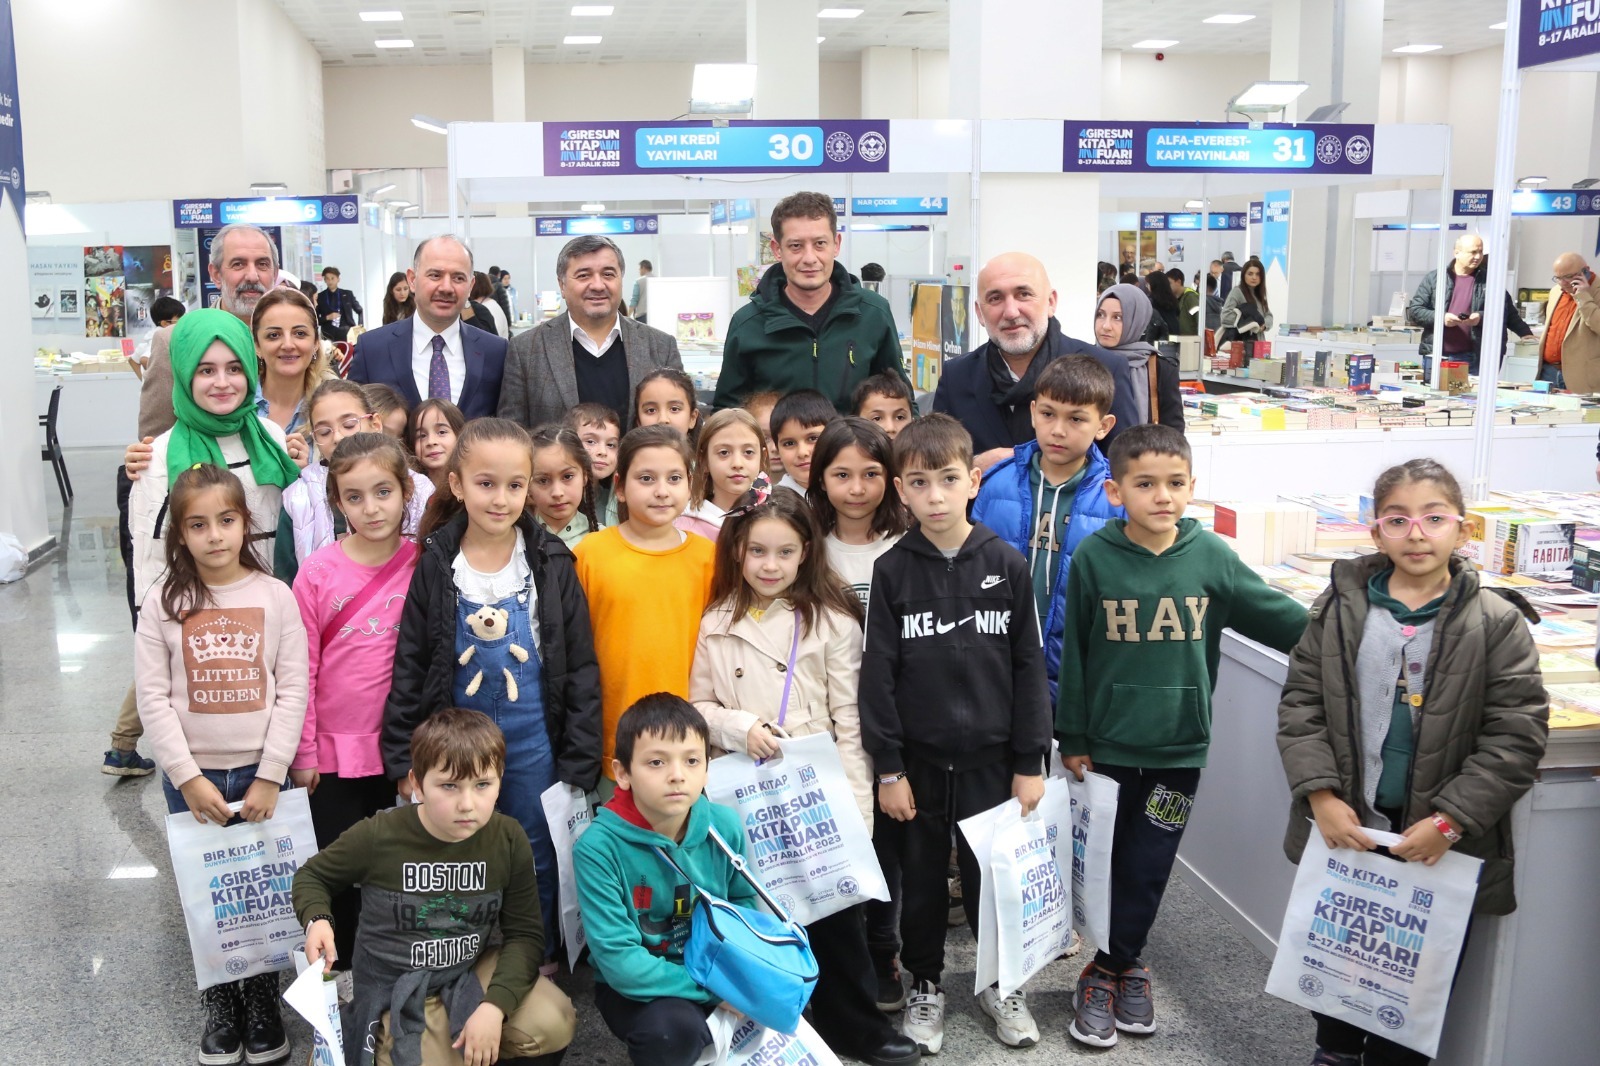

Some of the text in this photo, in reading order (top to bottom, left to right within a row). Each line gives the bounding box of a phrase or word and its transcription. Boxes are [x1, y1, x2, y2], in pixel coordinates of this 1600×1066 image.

[1562, 20, 1600, 41] ARALI
[646, 132, 720, 145] YAPI KREDİ
[768, 134, 814, 160] 30
[580, 150, 620, 160] FUARI
[646, 149, 717, 160] YAYINLARI
[1096, 149, 1132, 159] FUARI
[1156, 150, 1250, 161] KAPI YAYINLARI
[1272, 136, 1306, 162] 31
[304, 204, 317, 218] 6
[874, 199, 898, 207] ÇOCUK
[920, 198, 943, 209] 44
[1552, 196, 1572, 210] 43
[623, 220, 631, 230] 5
[1218, 218, 1225, 226] 3
[945, 341, 962, 354] Orhan
[1533, 547, 1569, 563] RABITA
[985, 575, 1000, 583] NIKE
[901, 611, 934, 639] IKE
[1102, 596, 1210, 642] HAY
[192, 668, 259, 682] LITTLE
[194, 688, 260, 704] QUEEN
[759, 774, 788, 791] KİTAP
[748, 815, 801, 843] KİTAP
[781, 818, 838, 849] FUARI
[203, 840, 265, 862] BİR KİTAP
[758, 835, 841, 867] 8-17 ARALIK 2023
[403, 861, 486, 892] BOSTON
[1327, 858, 1399, 889] BİR KİTAP
[212, 880, 270, 905] KİTAP
[245, 892, 292, 913] FUAR
[217, 917, 238, 928] 8-17
[241, 908, 278, 923] ARALIK
[1314, 900, 1386, 935] KİTAP
[411, 934, 480, 969] CELTICS
[1308, 932, 1415, 978] 8-17 ARALIK 2023
[1345, 930, 1420, 968] FUARI
